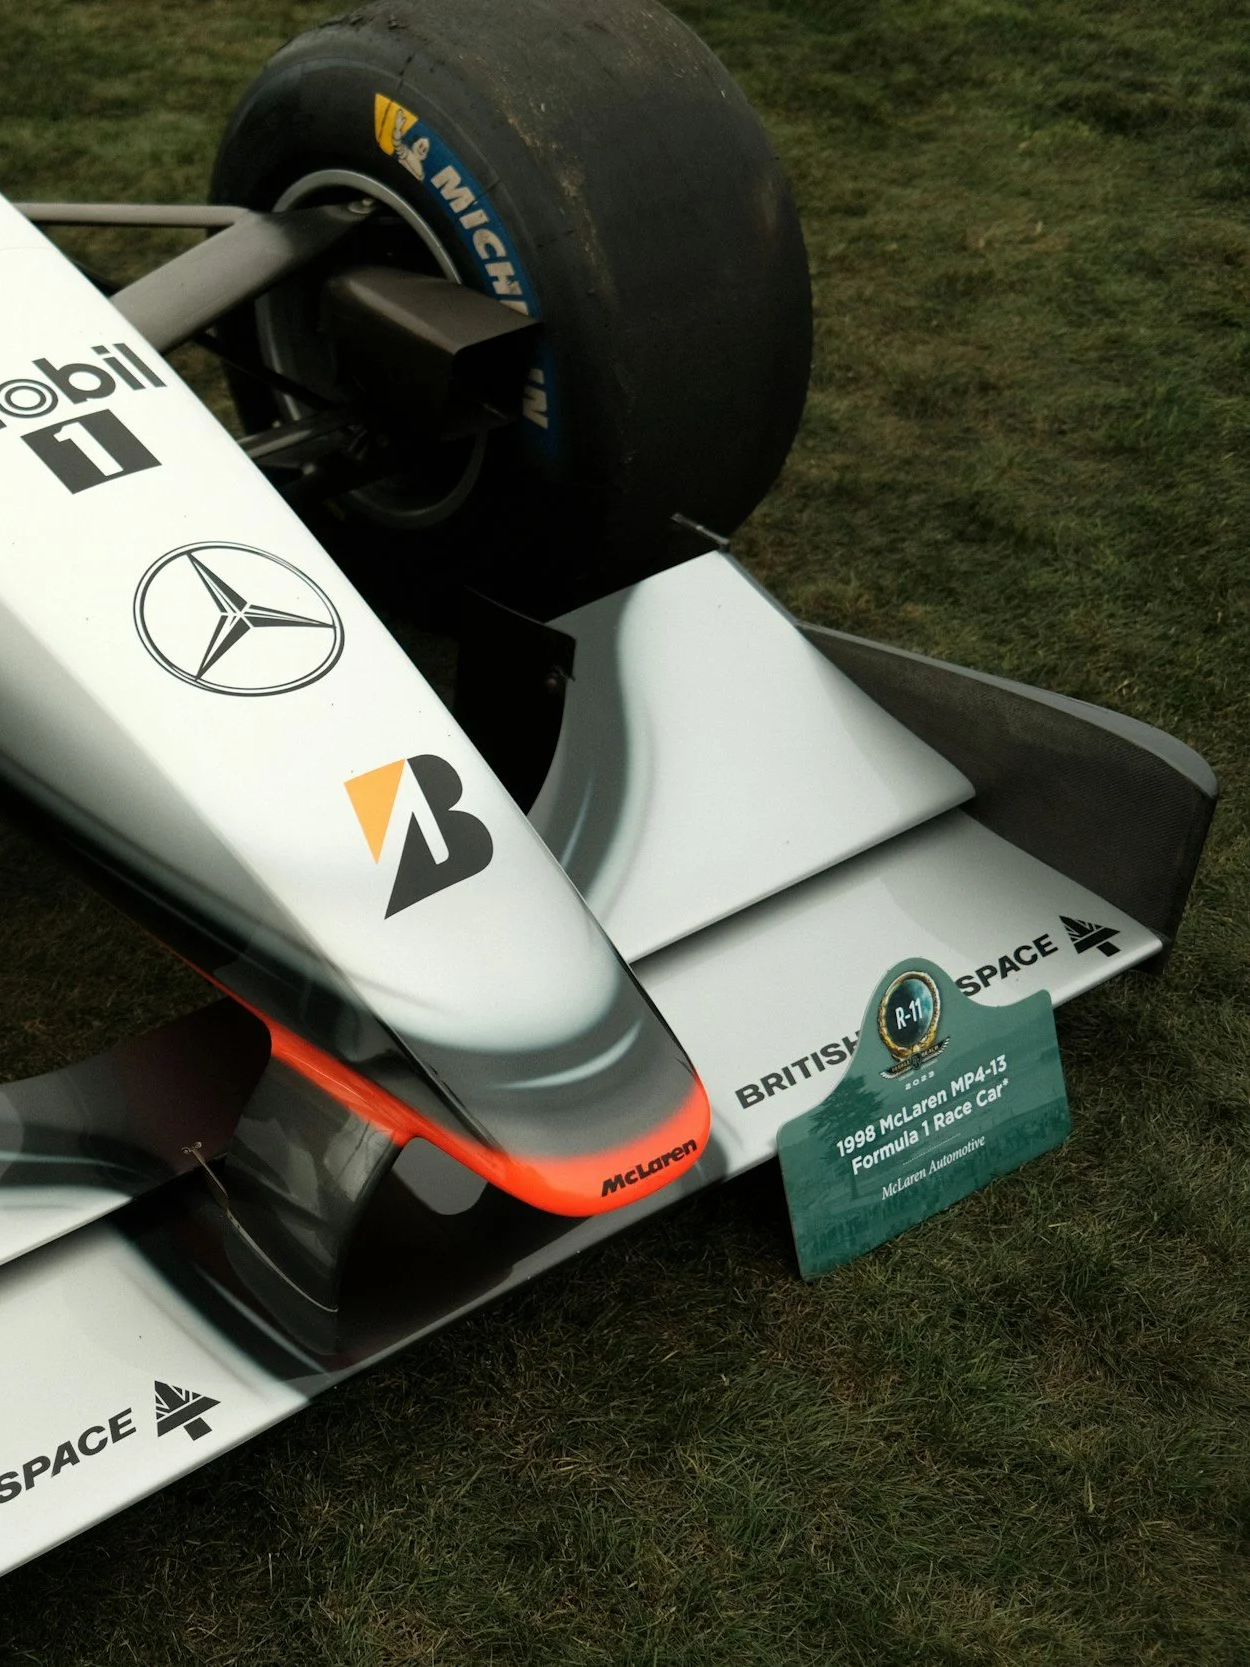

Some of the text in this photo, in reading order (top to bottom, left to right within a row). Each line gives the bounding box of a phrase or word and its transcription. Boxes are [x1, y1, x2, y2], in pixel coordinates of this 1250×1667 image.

[431, 165, 549, 429] MICHIN
[955, 933, 1059, 997] SPACE
[895, 997, 923, 1030] R-11
[836, 1054, 1007, 1157] 1998 McLaren MP4-13
[905, 1071, 935, 1090] 2023
[601, 1138, 698, 1197] McLaren
[851, 1129, 919, 1175] Formula
[921, 1120, 930, 1136] 1
[933, 1101, 972, 1131] Race
[881, 1135, 986, 1200] McLaren Automotive
